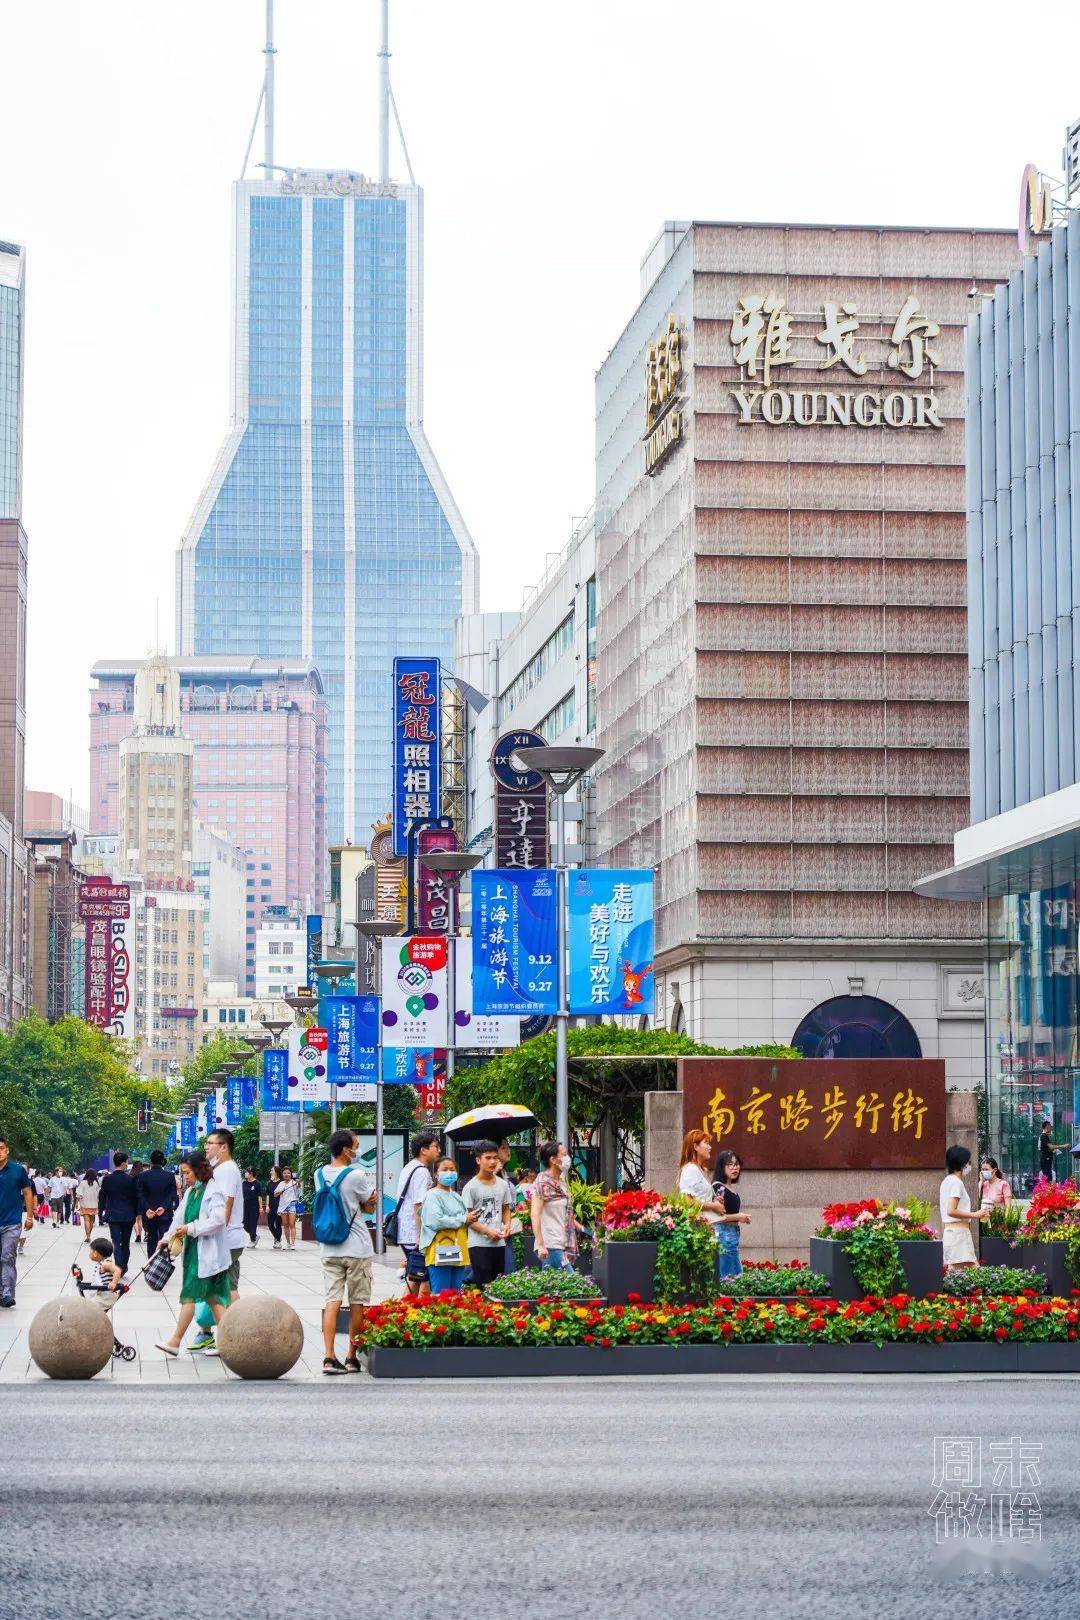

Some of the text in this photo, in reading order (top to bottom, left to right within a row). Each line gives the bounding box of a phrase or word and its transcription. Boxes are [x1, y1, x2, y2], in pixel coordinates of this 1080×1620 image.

[730, 295, 943, 387] 雅戈尔
[729, 389, 945, 428] YOUNGOR
[516, 776, 528, 785] VI
[115, 905, 128, 916] 9F
[427, 879, 449, 930] 茂昌
[612, 882, 633, 923] 走进
[489, 884, 510, 990] 上海旅游节
[528, 955, 552, 965] 9.12
[589, 904, 611, 1004] 美好与欢乐
[90, 920, 107, 1025] 茂昌眼镜验配中心
[528, 982, 552, 992] 9.27
[338, 1004, 350, 1069] 上海旅游节
[703, 1085, 928, 1142] 南京路步行街
